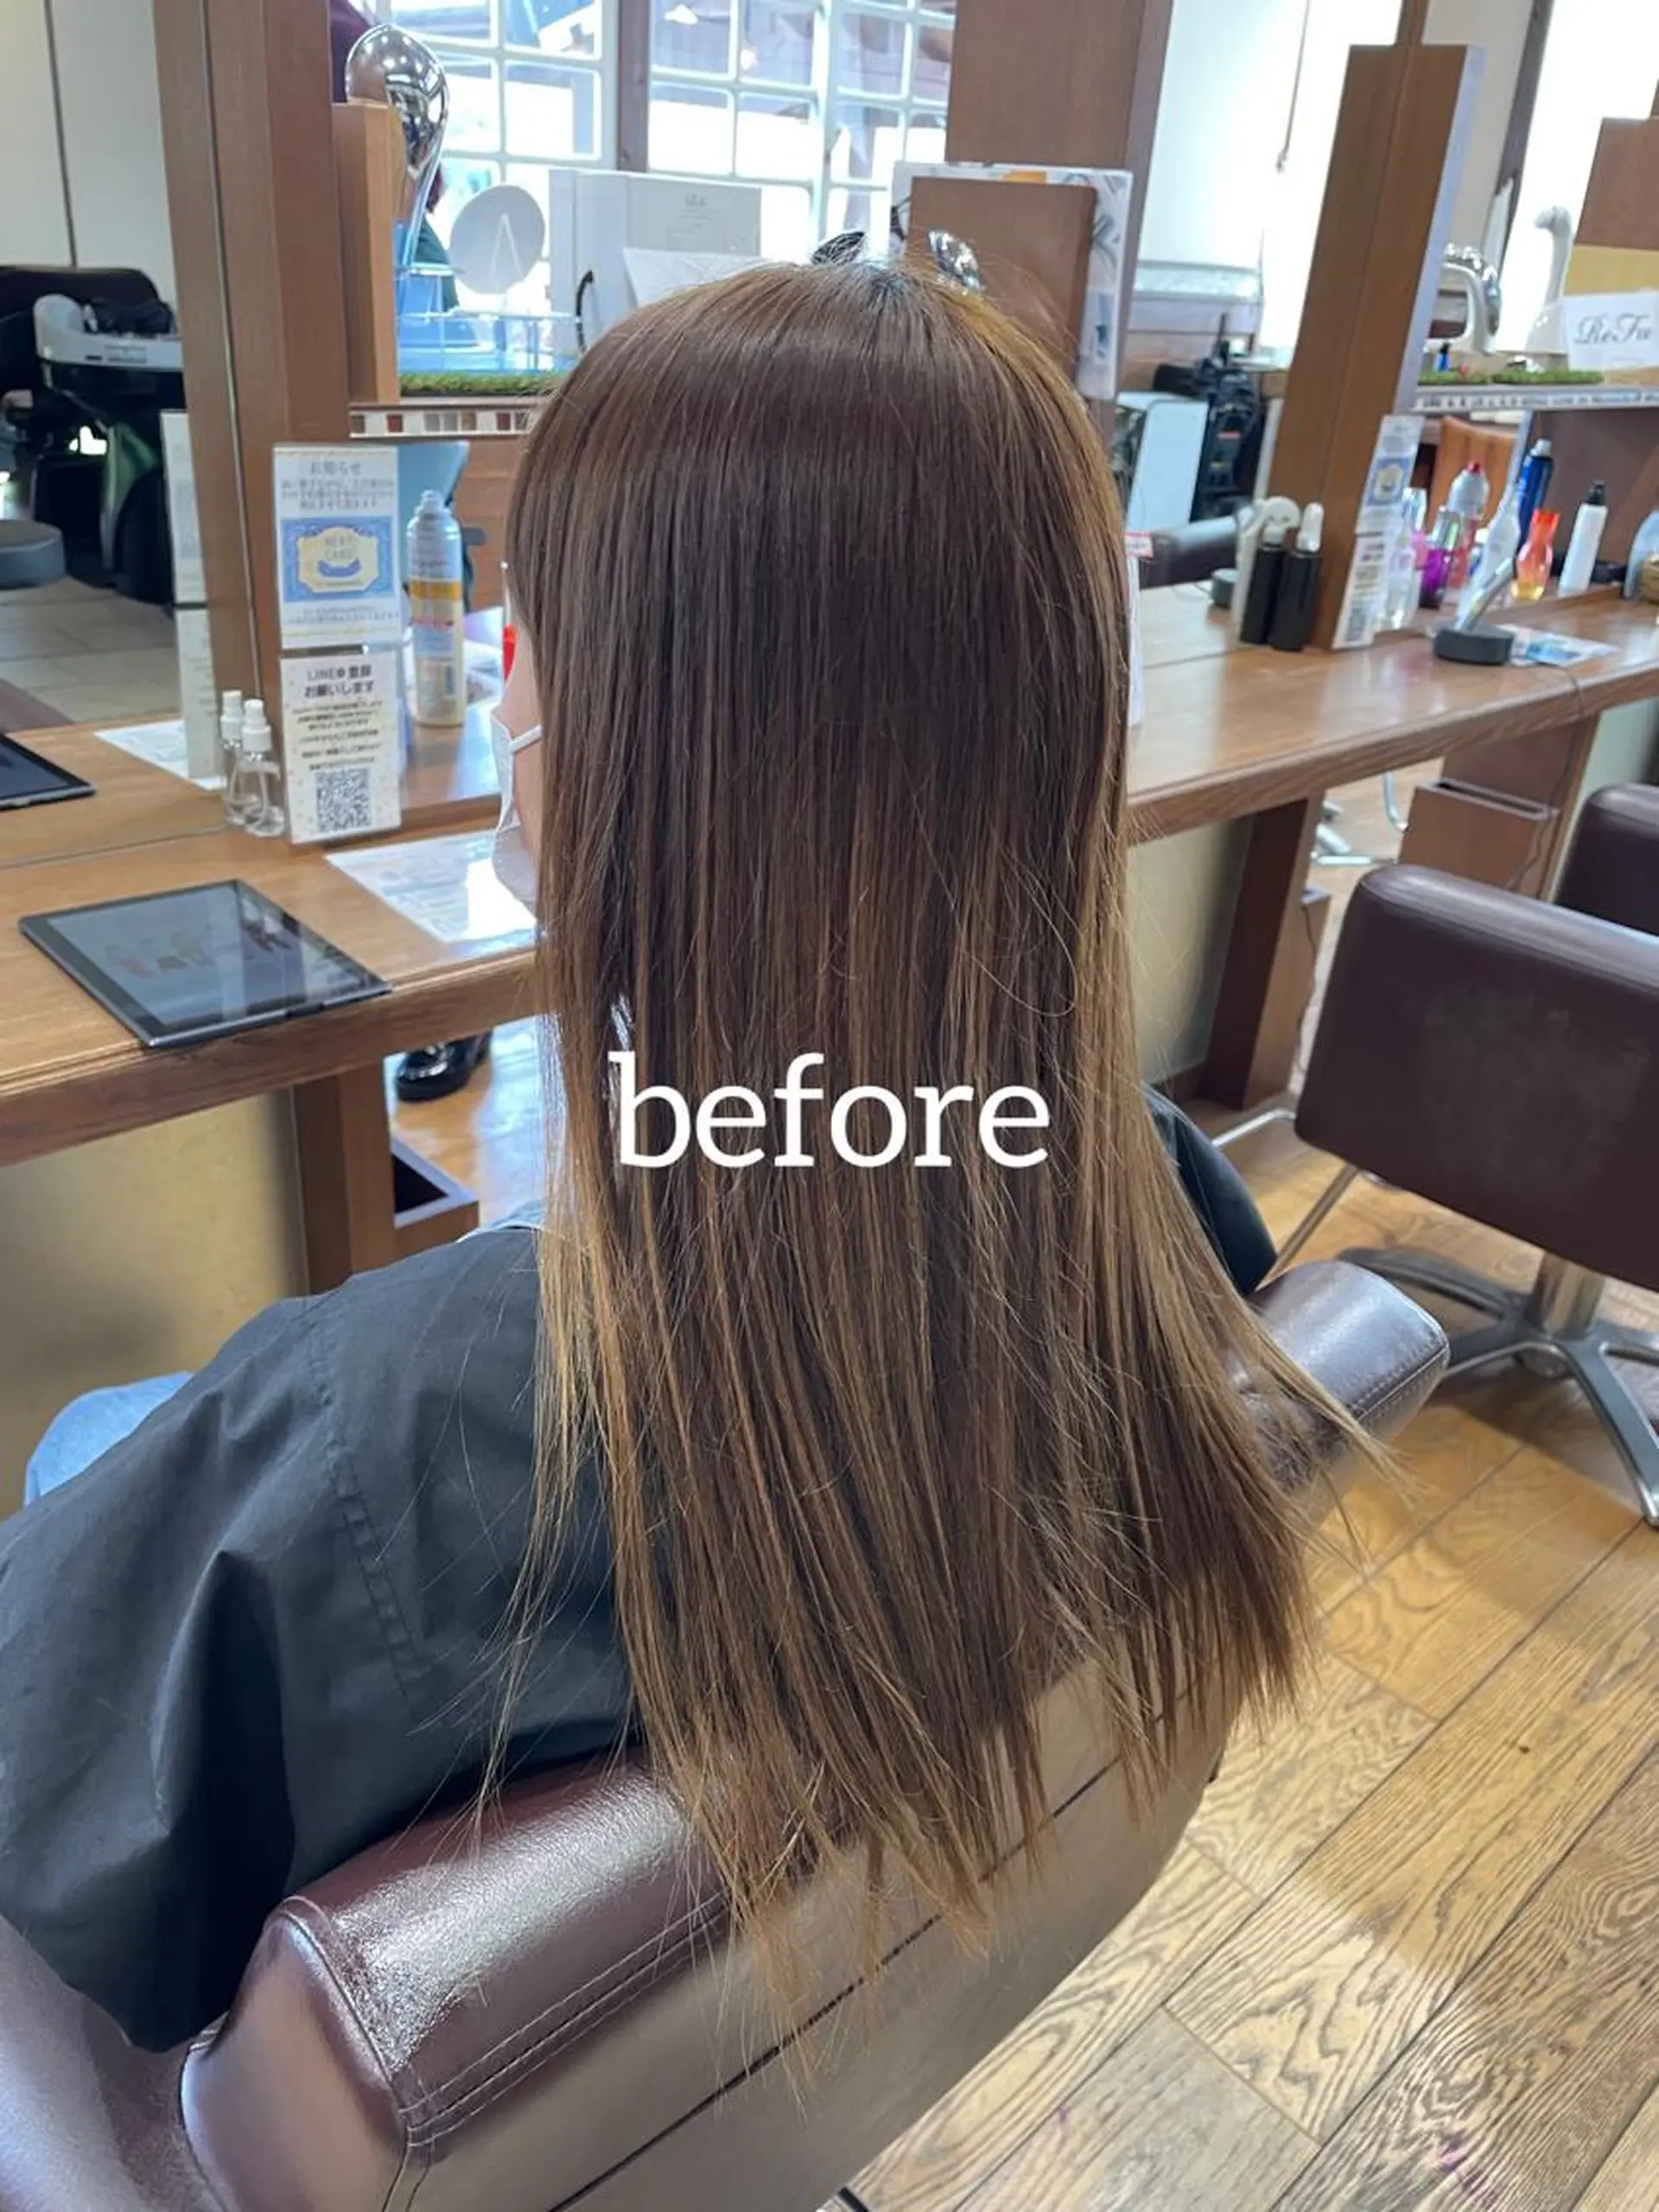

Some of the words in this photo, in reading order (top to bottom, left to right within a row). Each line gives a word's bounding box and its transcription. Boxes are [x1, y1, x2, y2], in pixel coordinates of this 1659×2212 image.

[305, 680, 374, 698] お願いします
